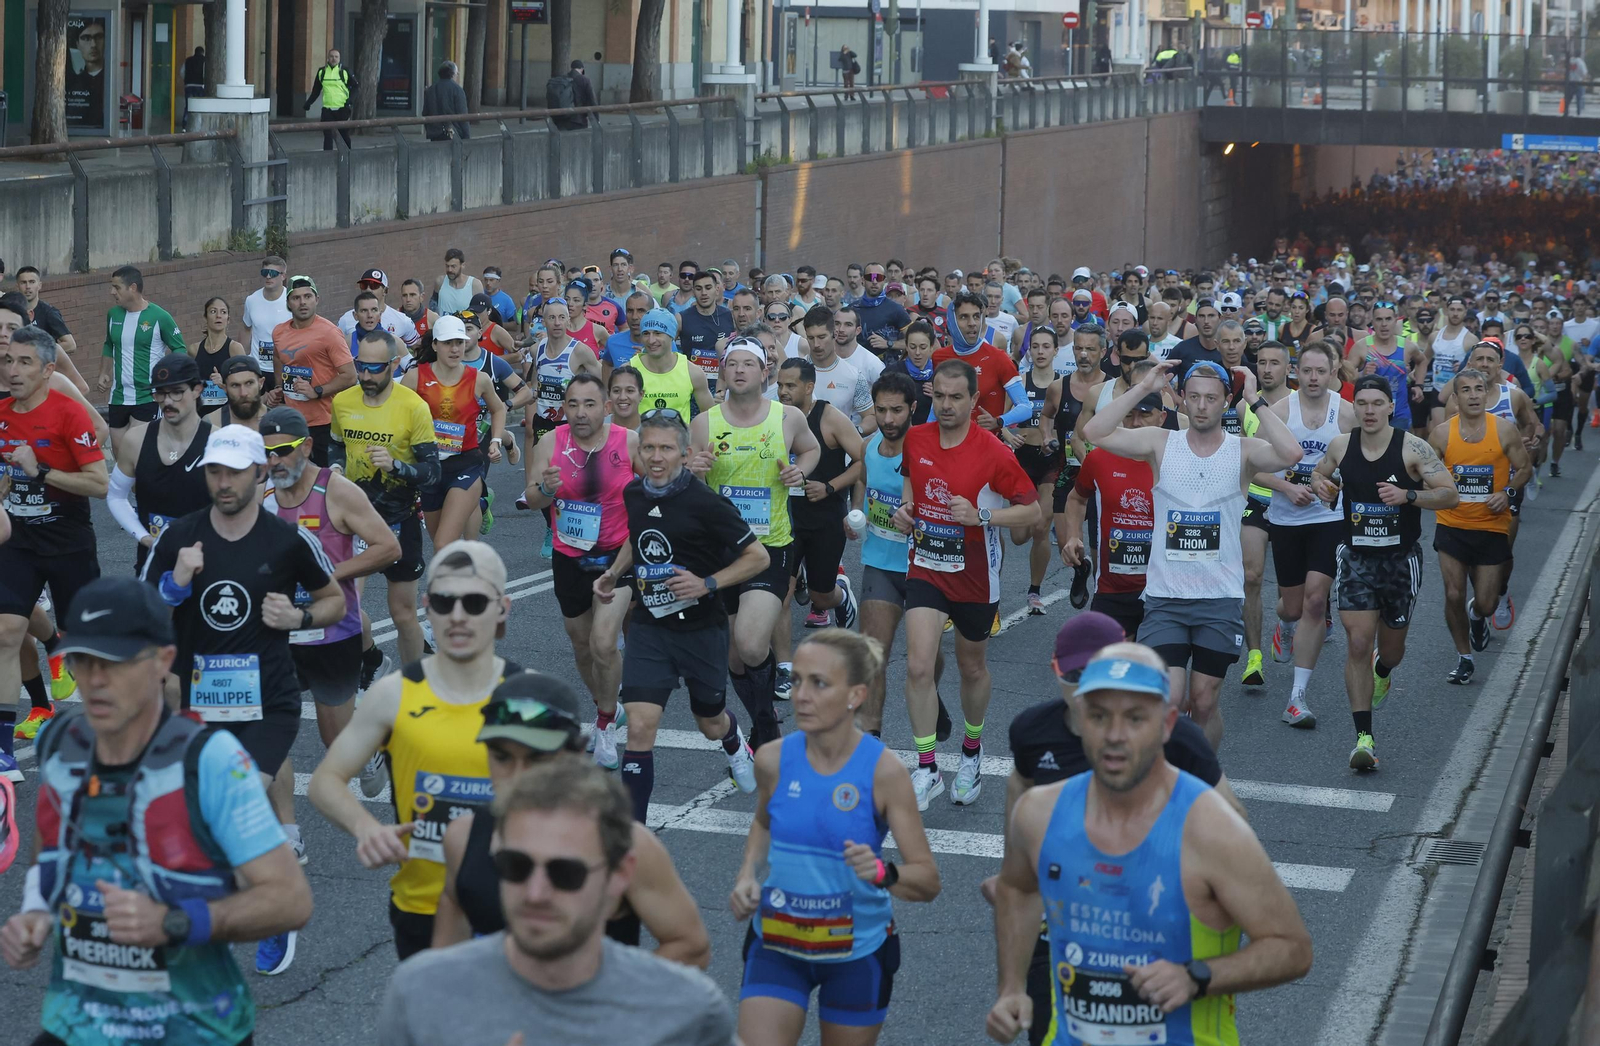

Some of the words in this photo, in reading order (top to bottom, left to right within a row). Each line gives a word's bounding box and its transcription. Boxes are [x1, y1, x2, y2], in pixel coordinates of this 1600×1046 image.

[542, 392, 560, 400] MAZZO
[436, 422, 460, 432] ZURICH
[344, 429, 394, 443] TRIBOOST
[1458, 484, 1489, 494] IOANNIS
[567, 503, 596, 513] ZURICH
[567, 516, 582, 525] 6718
[565, 526, 584, 538] JAVI
[1184, 528, 1202, 537] 3282
[1364, 526, 1388, 536] NICKI
[930, 540, 944, 548] 3454
[1178, 538, 1208, 549] THOM
[916, 547, 964, 562] ADRIANA-DIEGO
[1123, 554, 1145, 564] IVAN
[208, 658, 250, 668] ZURICH
[212, 678, 232, 688] 4807
[196, 691, 254, 704] PHILIPPE
[791, 897, 841, 909] ZURICH
[1070, 902, 1131, 926] ESTATE
[1070, 919, 1166, 944] BARCELONA
[66, 936, 156, 969] PIERRICK
[1088, 952, 1148, 968] ZURICH
